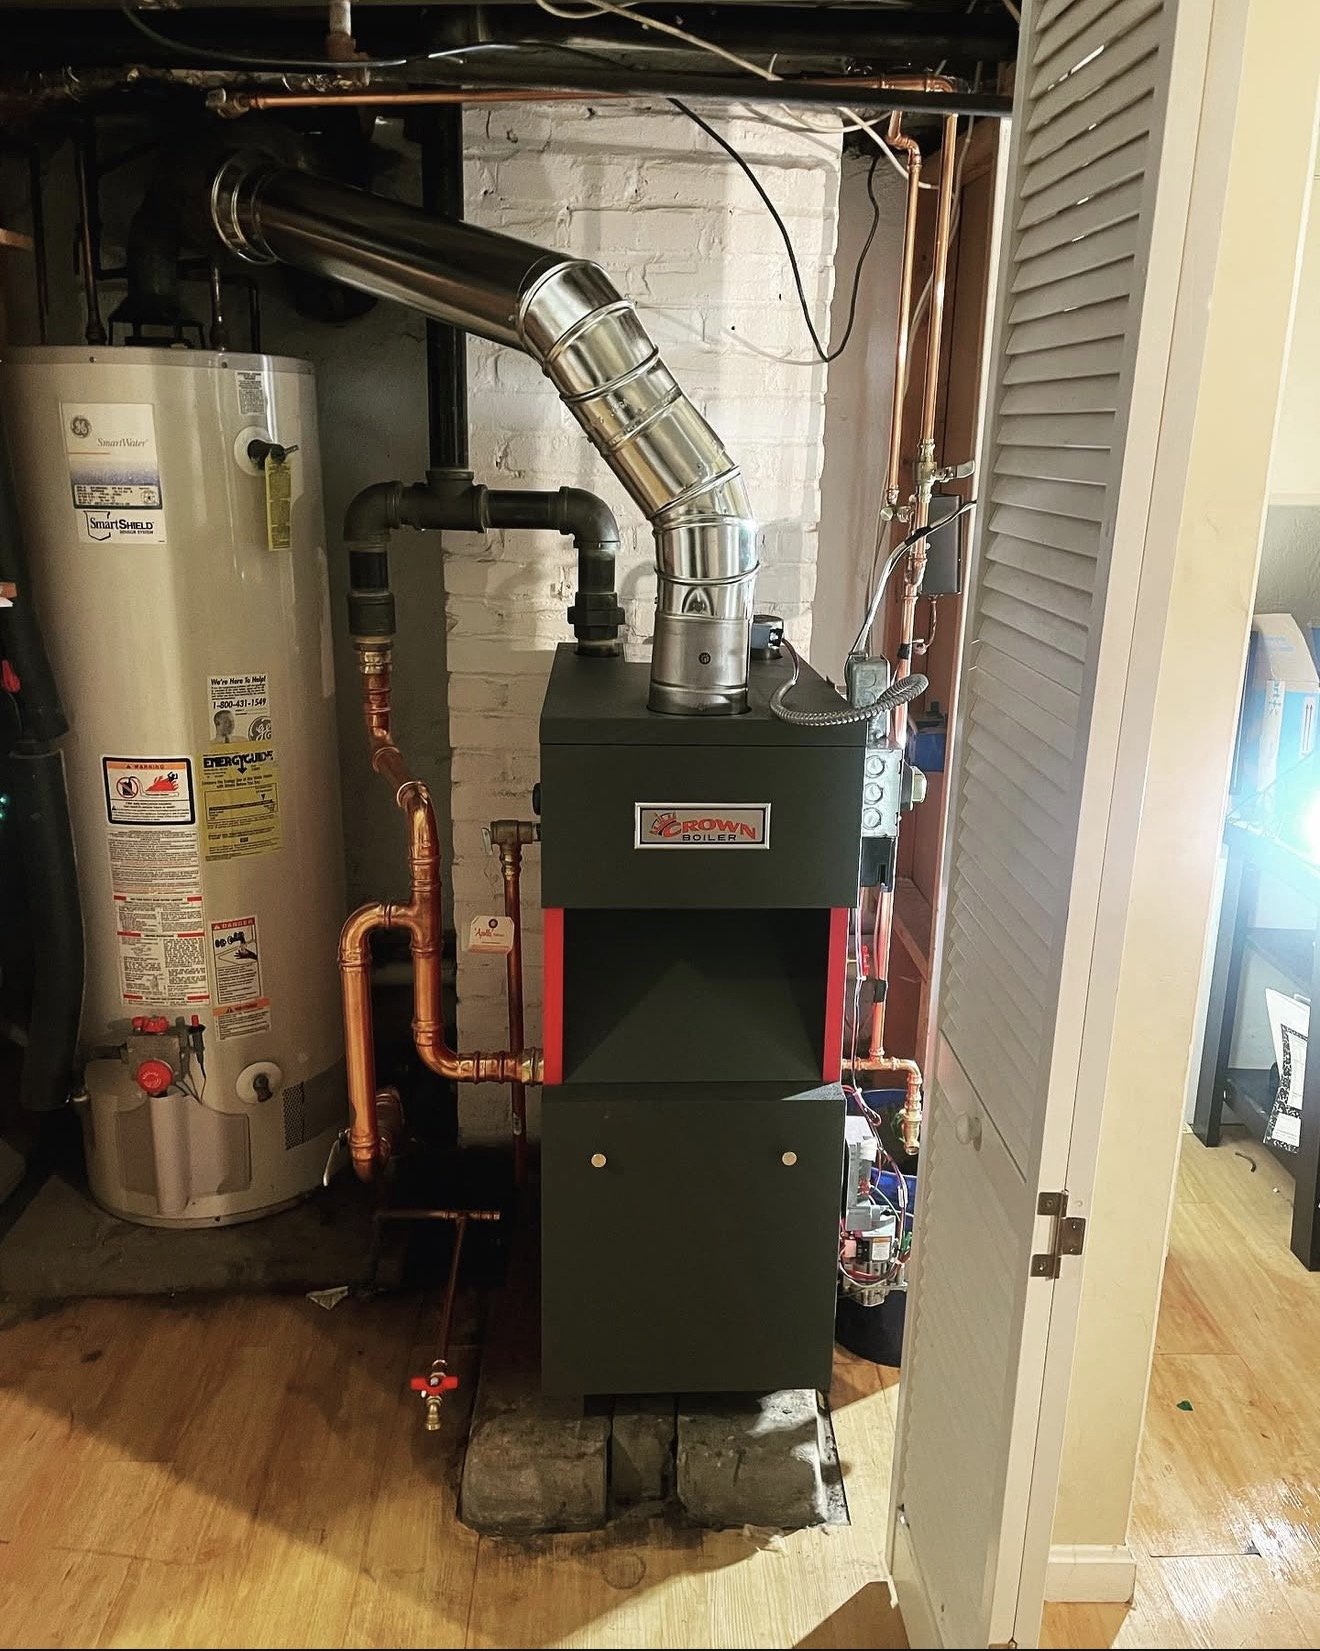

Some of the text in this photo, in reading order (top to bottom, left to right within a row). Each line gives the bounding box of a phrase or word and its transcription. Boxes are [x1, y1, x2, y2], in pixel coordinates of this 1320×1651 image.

[97, 437, 146, 447] SmartWater
[211, 678, 228, 686] We're
[229, 677, 243, 685] Here
[252, 675, 266, 684] Help!
[213, 698, 267, 710] 1-800-431-1549
[662, 818, 756, 840] CROWN
[222, 918, 254, 929] DANGER
